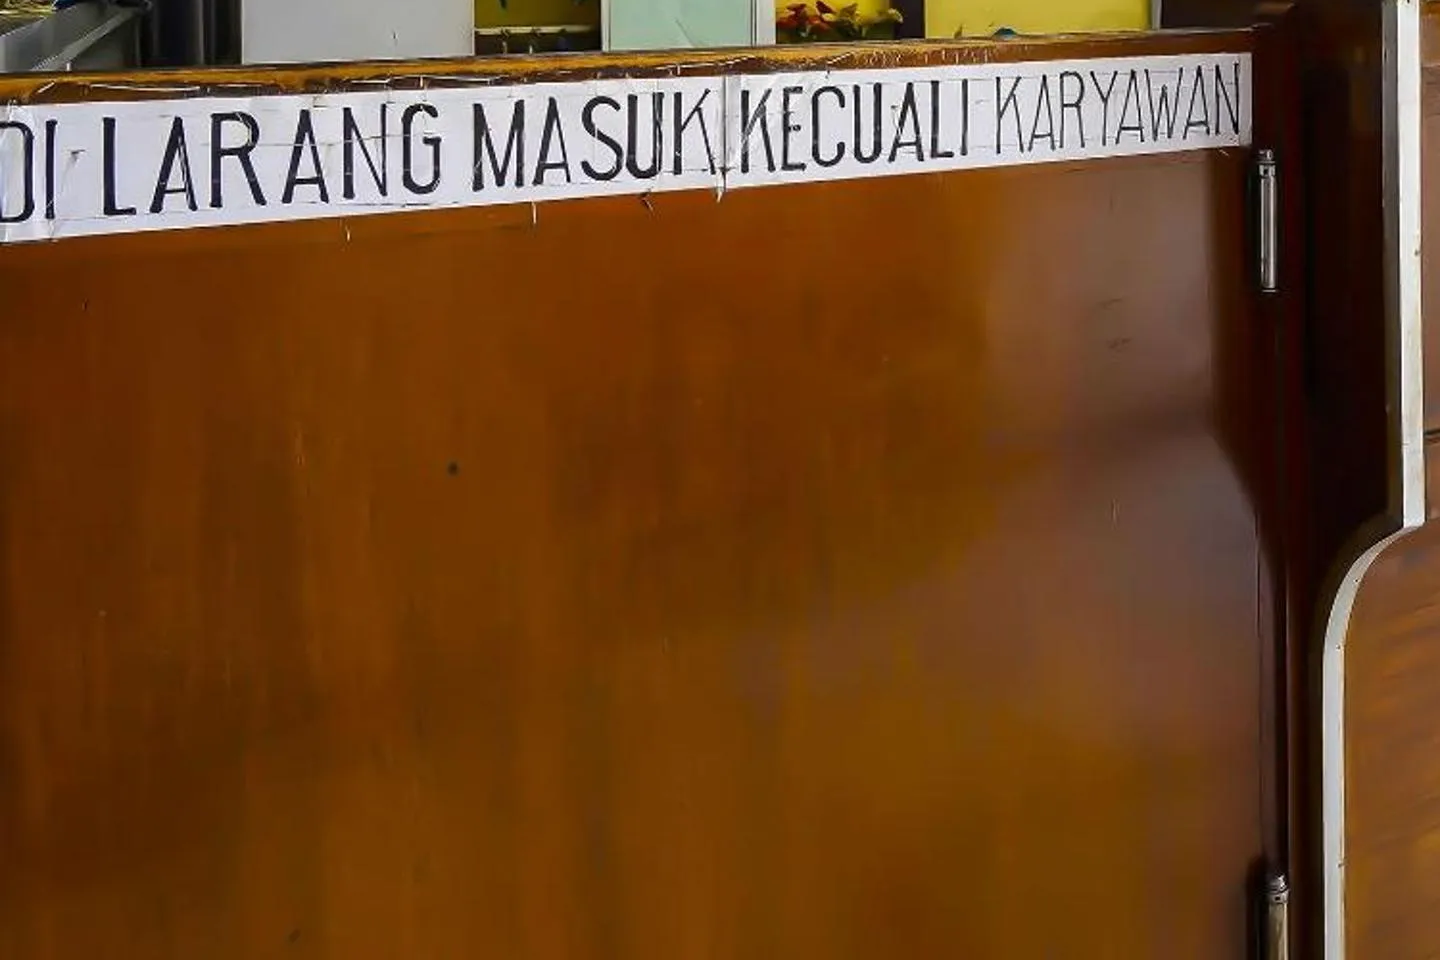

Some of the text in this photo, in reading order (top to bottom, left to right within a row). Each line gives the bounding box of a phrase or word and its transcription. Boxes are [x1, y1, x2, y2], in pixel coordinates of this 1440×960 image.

[0, 62, 1241, 223] DI LARANG MASUK KECUALI KARYAWAN
